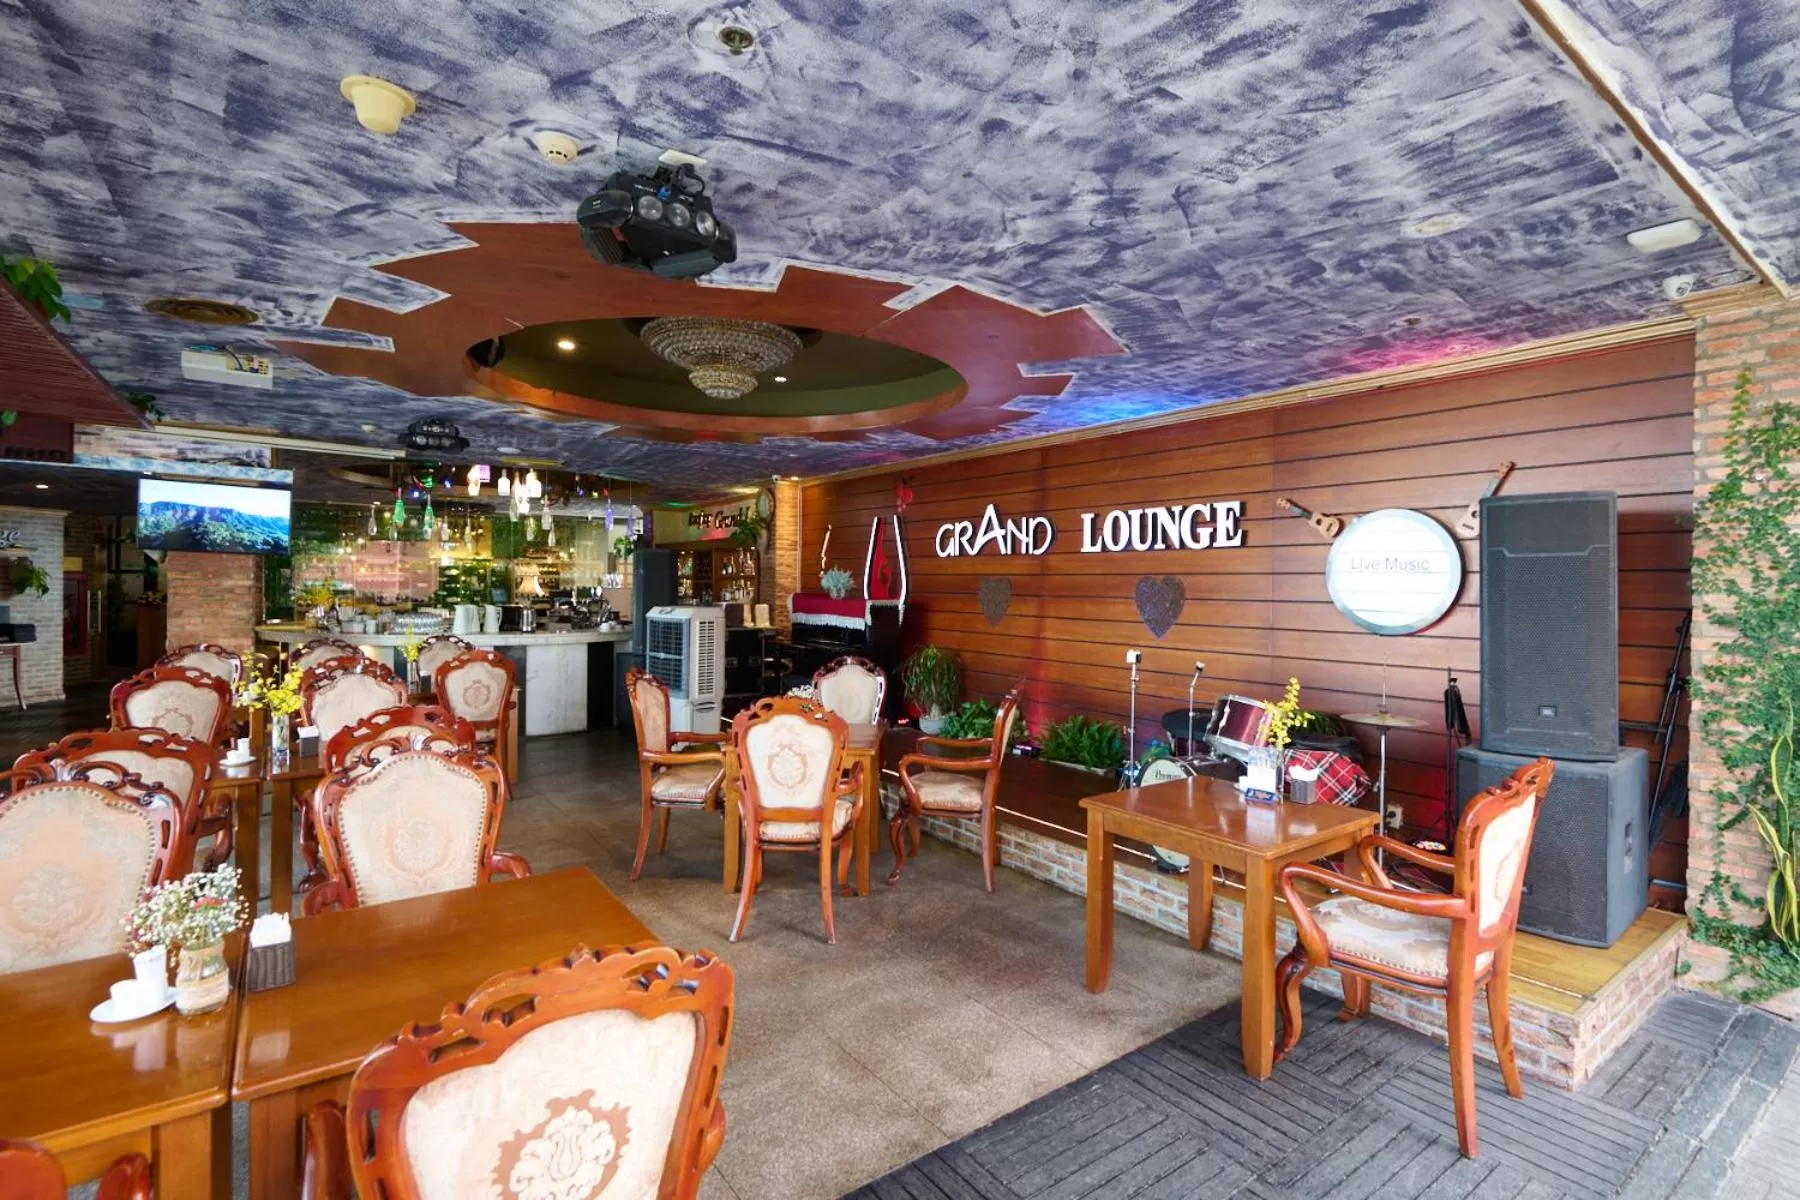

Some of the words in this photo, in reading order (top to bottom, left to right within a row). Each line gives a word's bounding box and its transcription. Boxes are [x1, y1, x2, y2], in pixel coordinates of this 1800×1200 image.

[935, 503, 1052, 558] GRAND
[1081, 500, 1244, 553] LOUNGE
[1350, 556, 1380, 570] Live
[1385, 556, 1431, 571] Music
